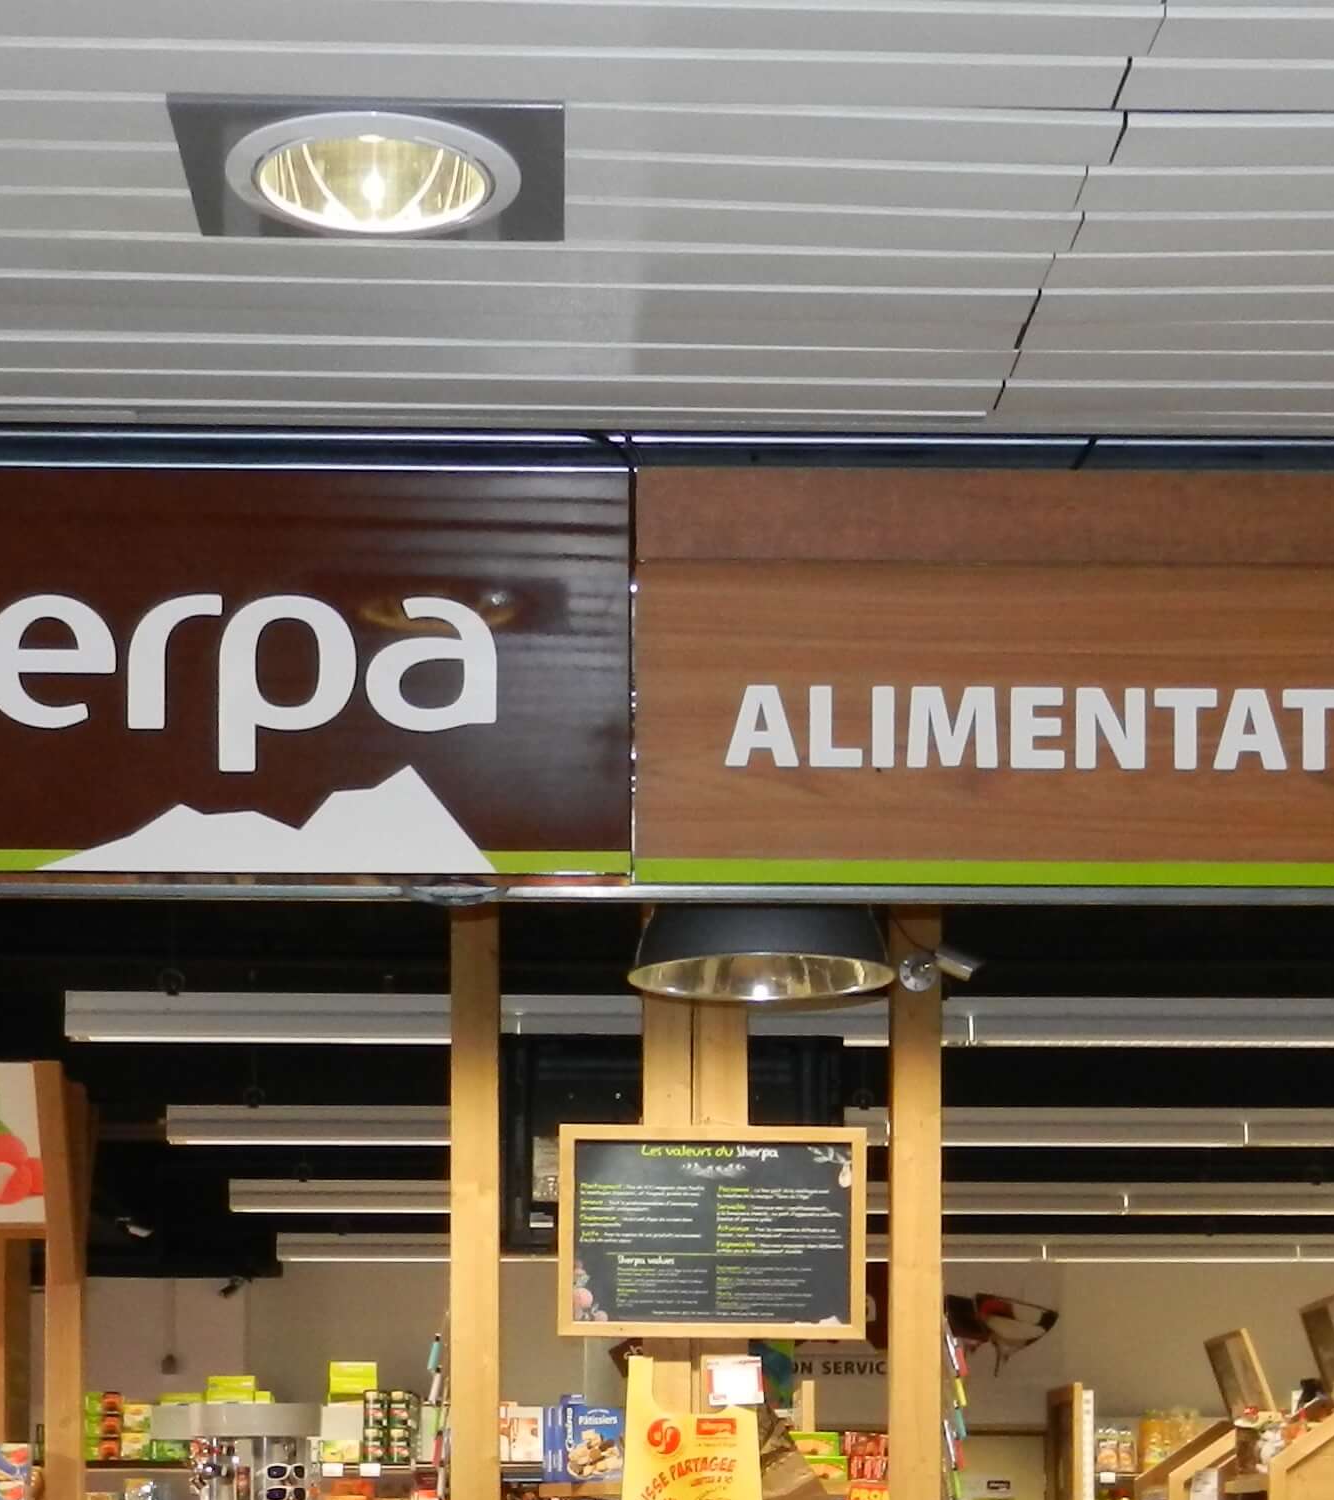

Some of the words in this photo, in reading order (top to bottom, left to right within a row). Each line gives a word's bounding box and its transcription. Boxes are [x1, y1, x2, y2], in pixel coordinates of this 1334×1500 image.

[641, 1145, 662, 1157] Les
[664, 1145, 714, 1158] valeurs
[715, 1146, 734, 1158] du
